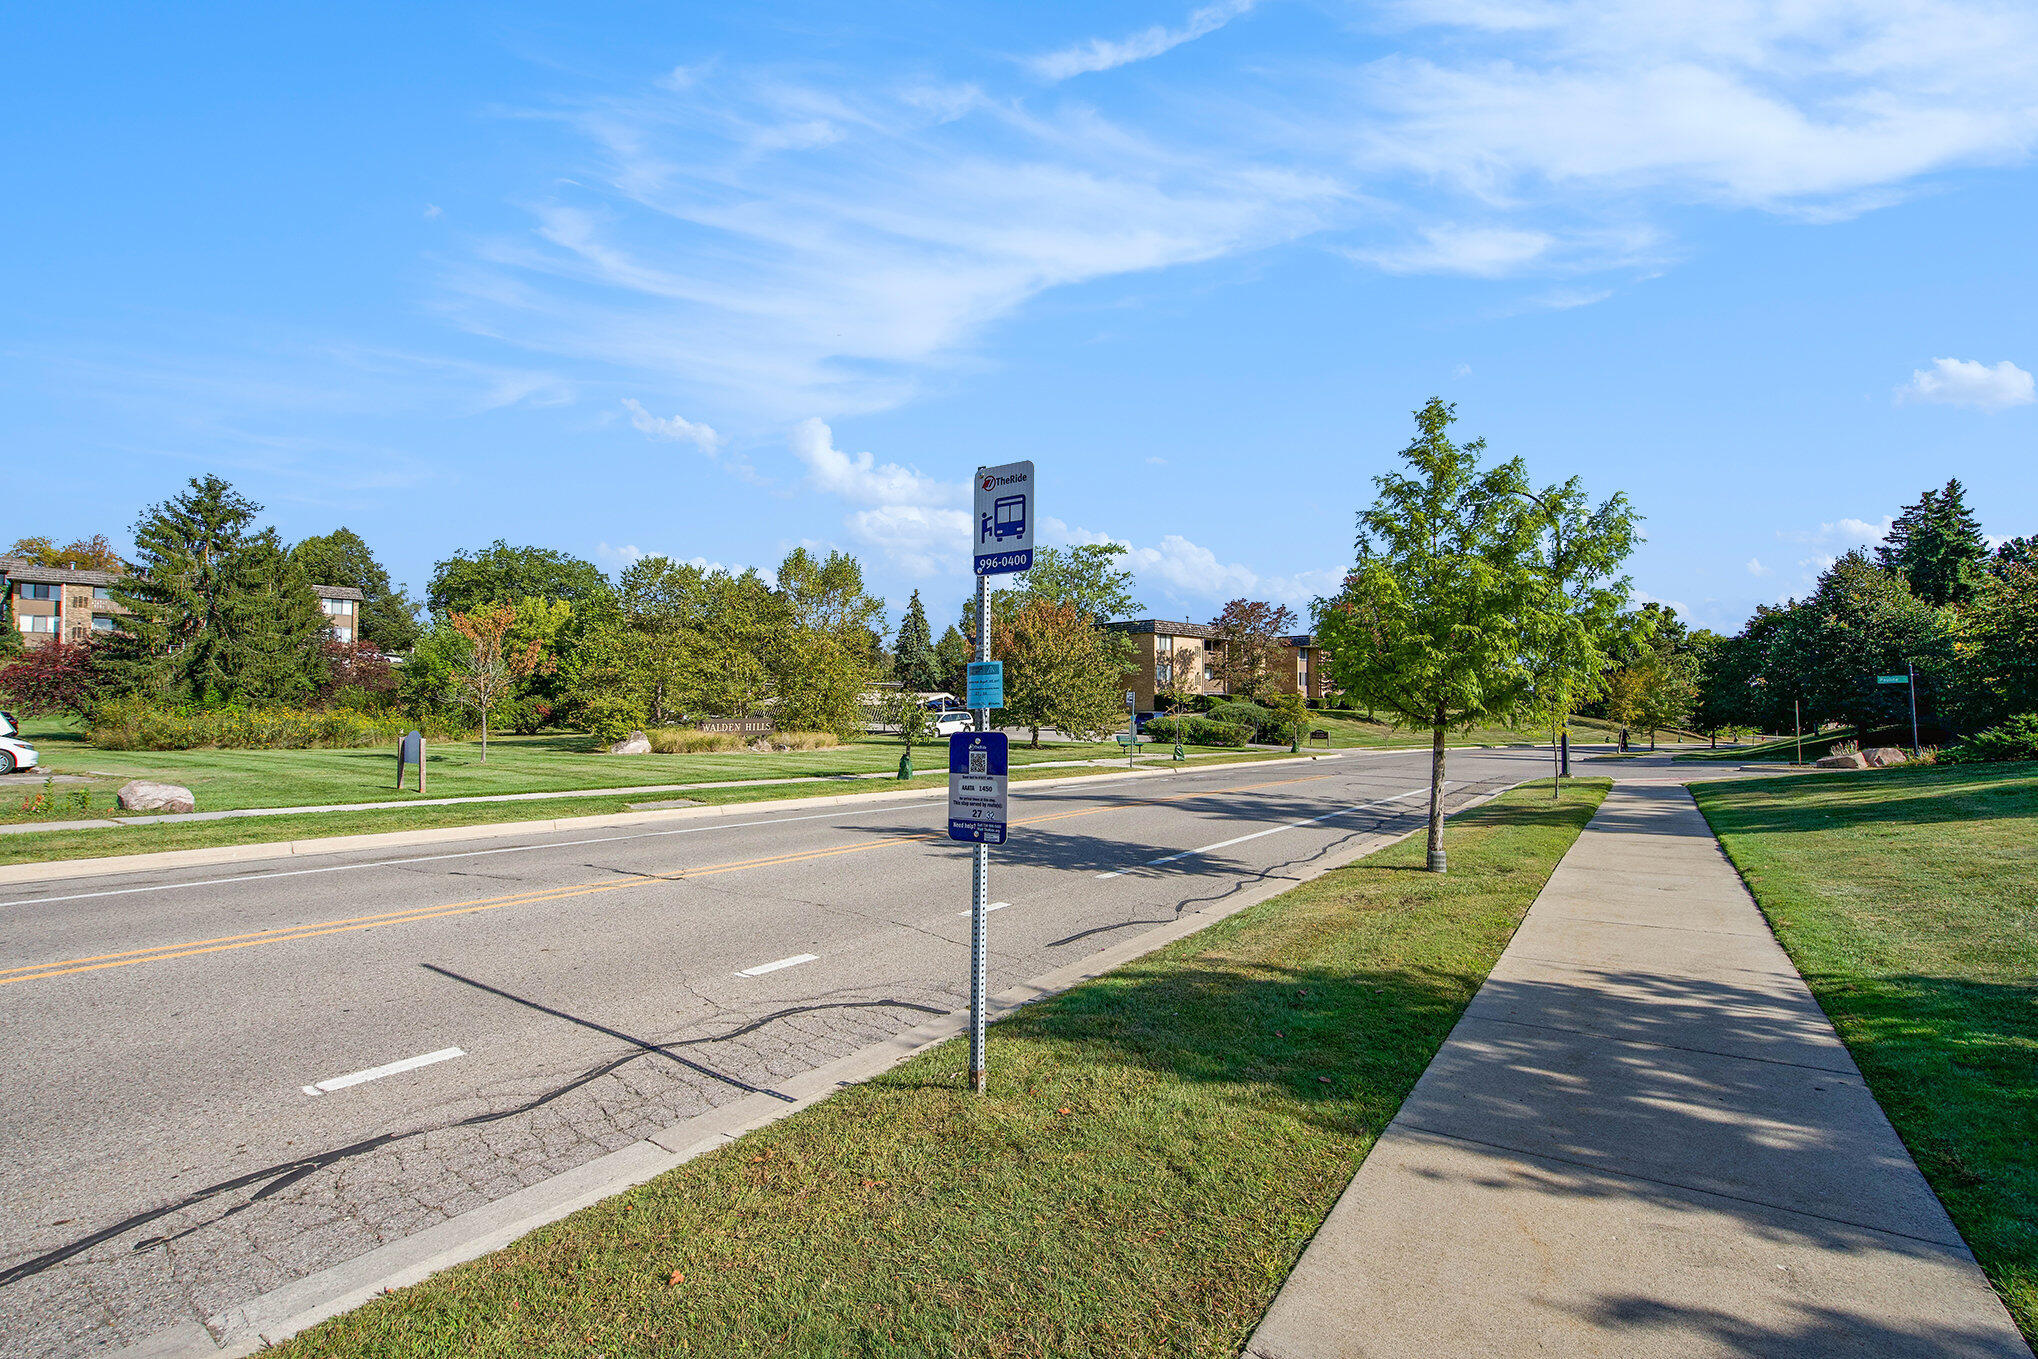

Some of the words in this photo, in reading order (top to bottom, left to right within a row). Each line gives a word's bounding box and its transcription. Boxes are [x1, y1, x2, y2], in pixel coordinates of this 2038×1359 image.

[996, 473, 1027, 486] TheRide
[979, 554, 1027, 569] 996-0400
[702, 723, 741, 732] WALDEN
[745, 722, 771, 731] HILLS
[972, 809, 982, 818] 27
[986, 811, 995, 820] 32
